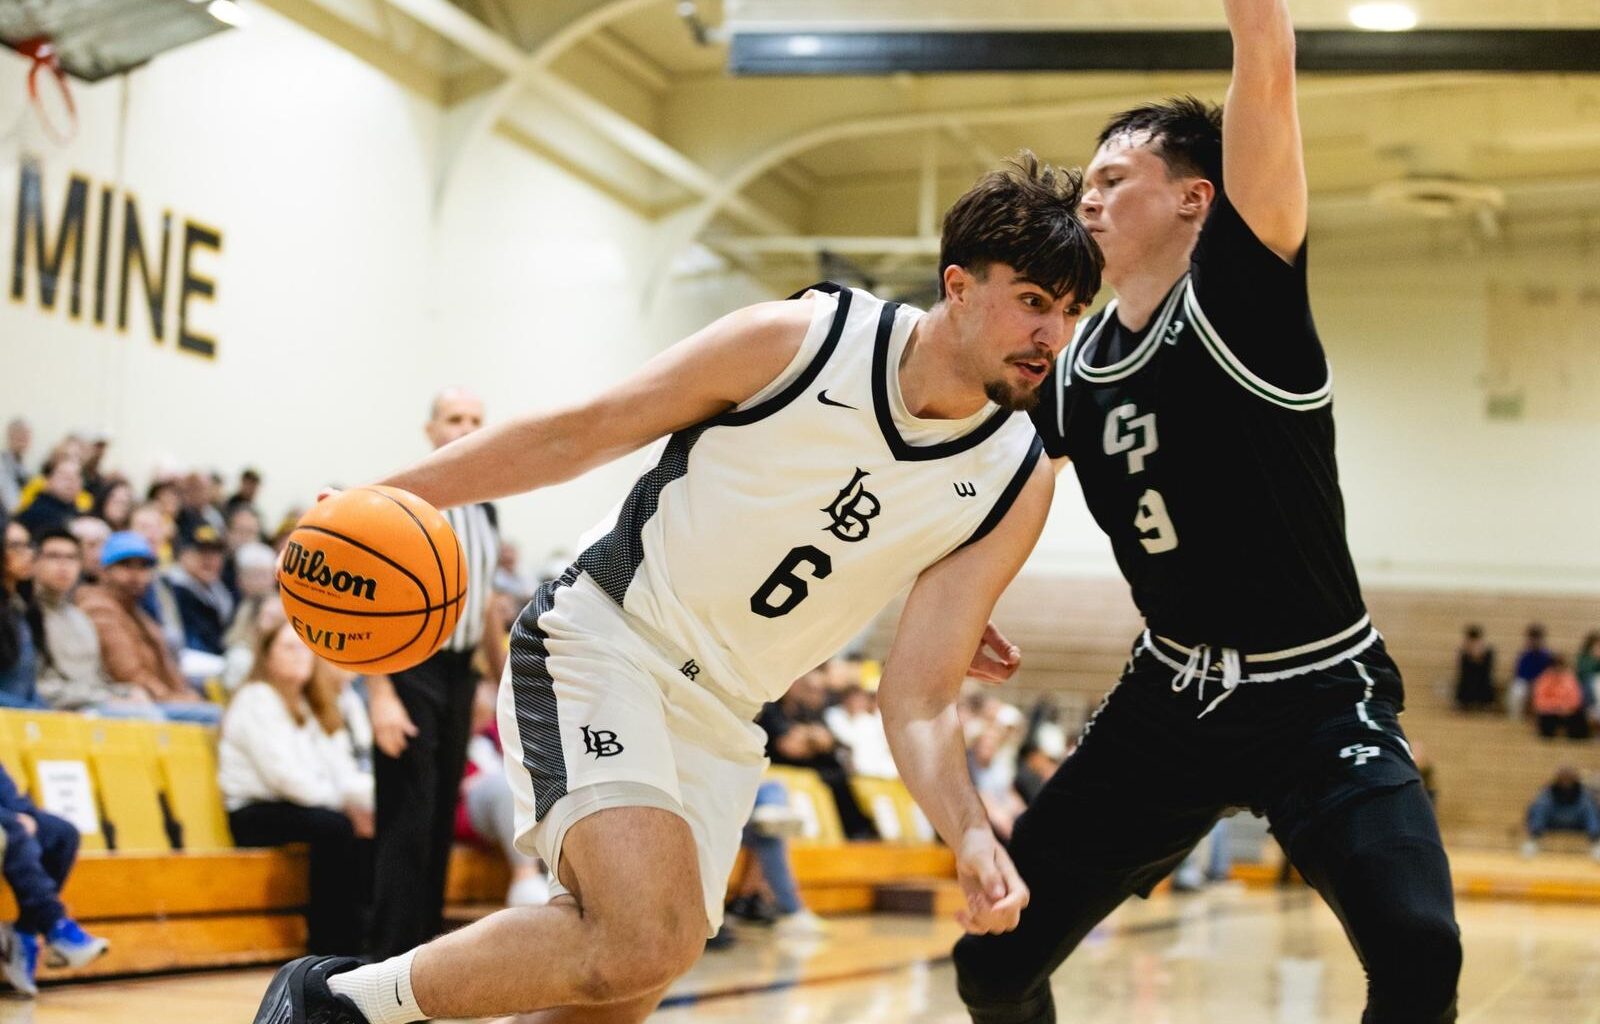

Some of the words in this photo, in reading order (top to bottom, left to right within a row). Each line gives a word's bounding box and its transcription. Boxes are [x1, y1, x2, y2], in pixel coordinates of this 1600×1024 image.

[10, 154, 222, 358] MINE
[1103, 403, 1159, 475] CP
[819, 466, 881, 542] LB
[1133, 488, 1179, 554] 9
[282, 540, 377, 602] Wilson
[750, 544, 833, 619] 6
[348, 631, 373, 641] NXT
[579, 724, 624, 761] LB
